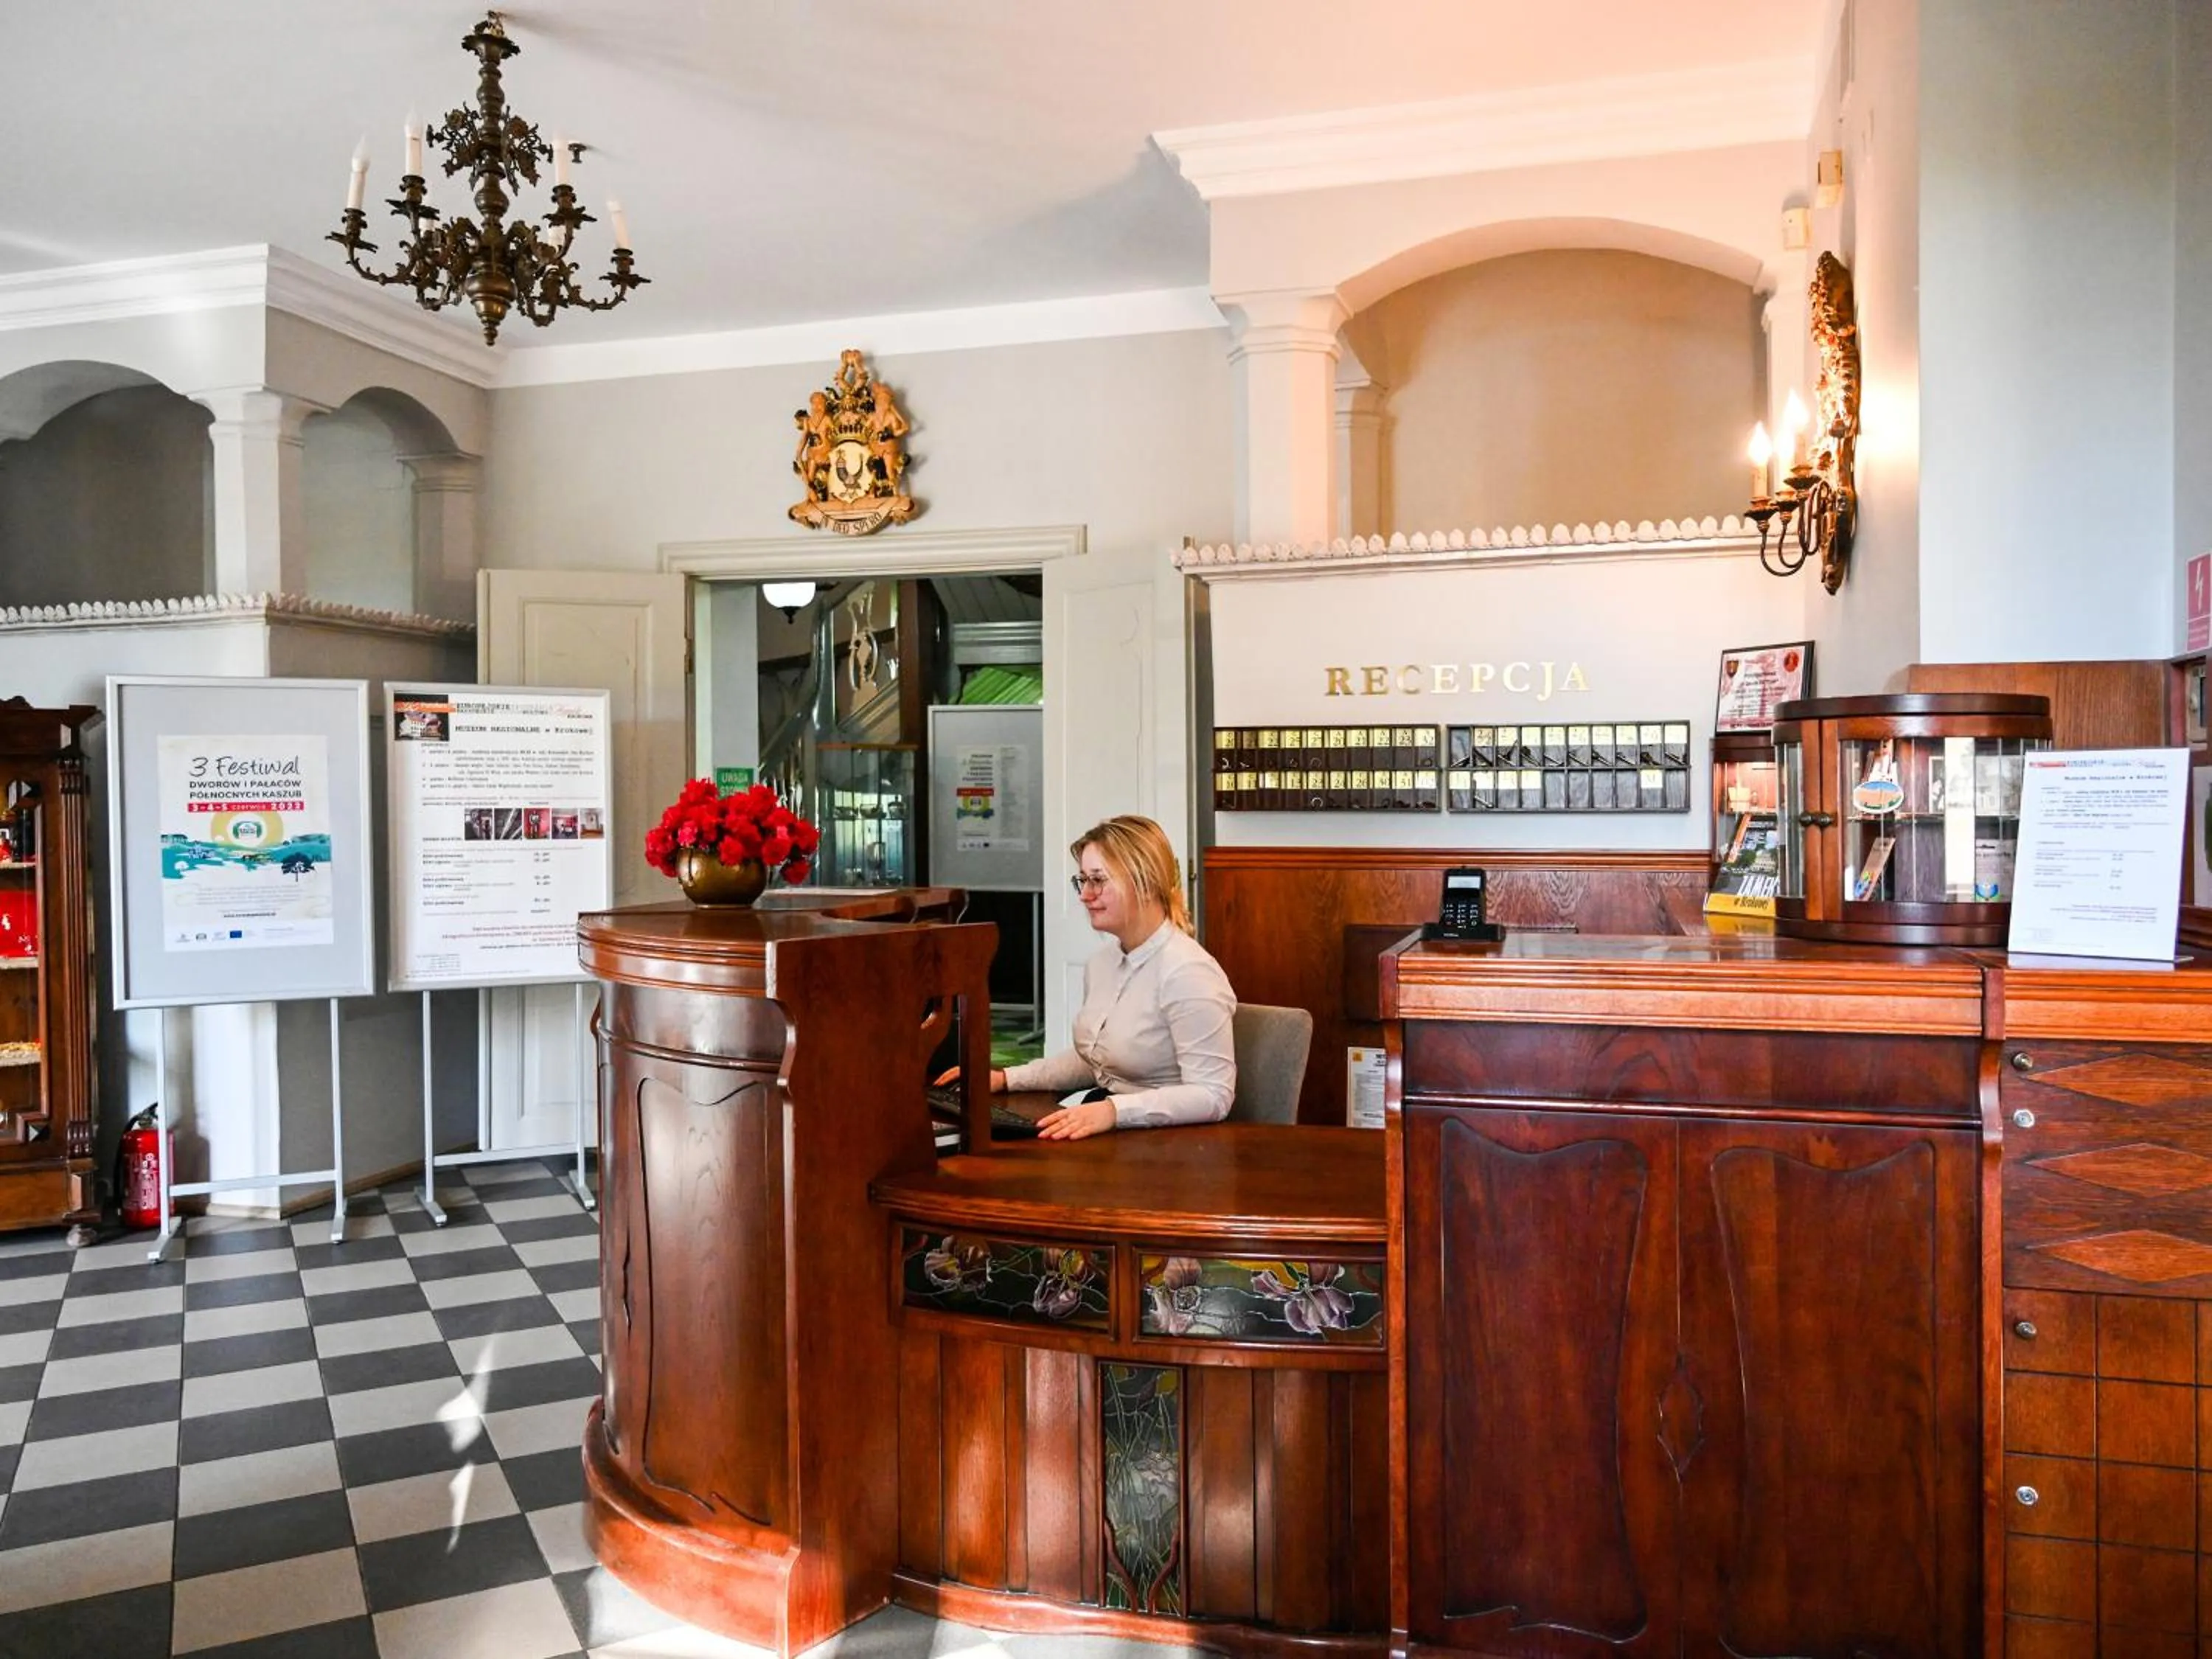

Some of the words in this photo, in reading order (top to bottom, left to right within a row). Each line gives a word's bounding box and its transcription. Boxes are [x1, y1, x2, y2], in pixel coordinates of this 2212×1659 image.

[1324, 661, 1593, 701] RECEPCJA
[189, 757, 209, 777] 3
[216, 754, 301, 776] Festiwal
[262, 790, 302, 798] KASZUB
